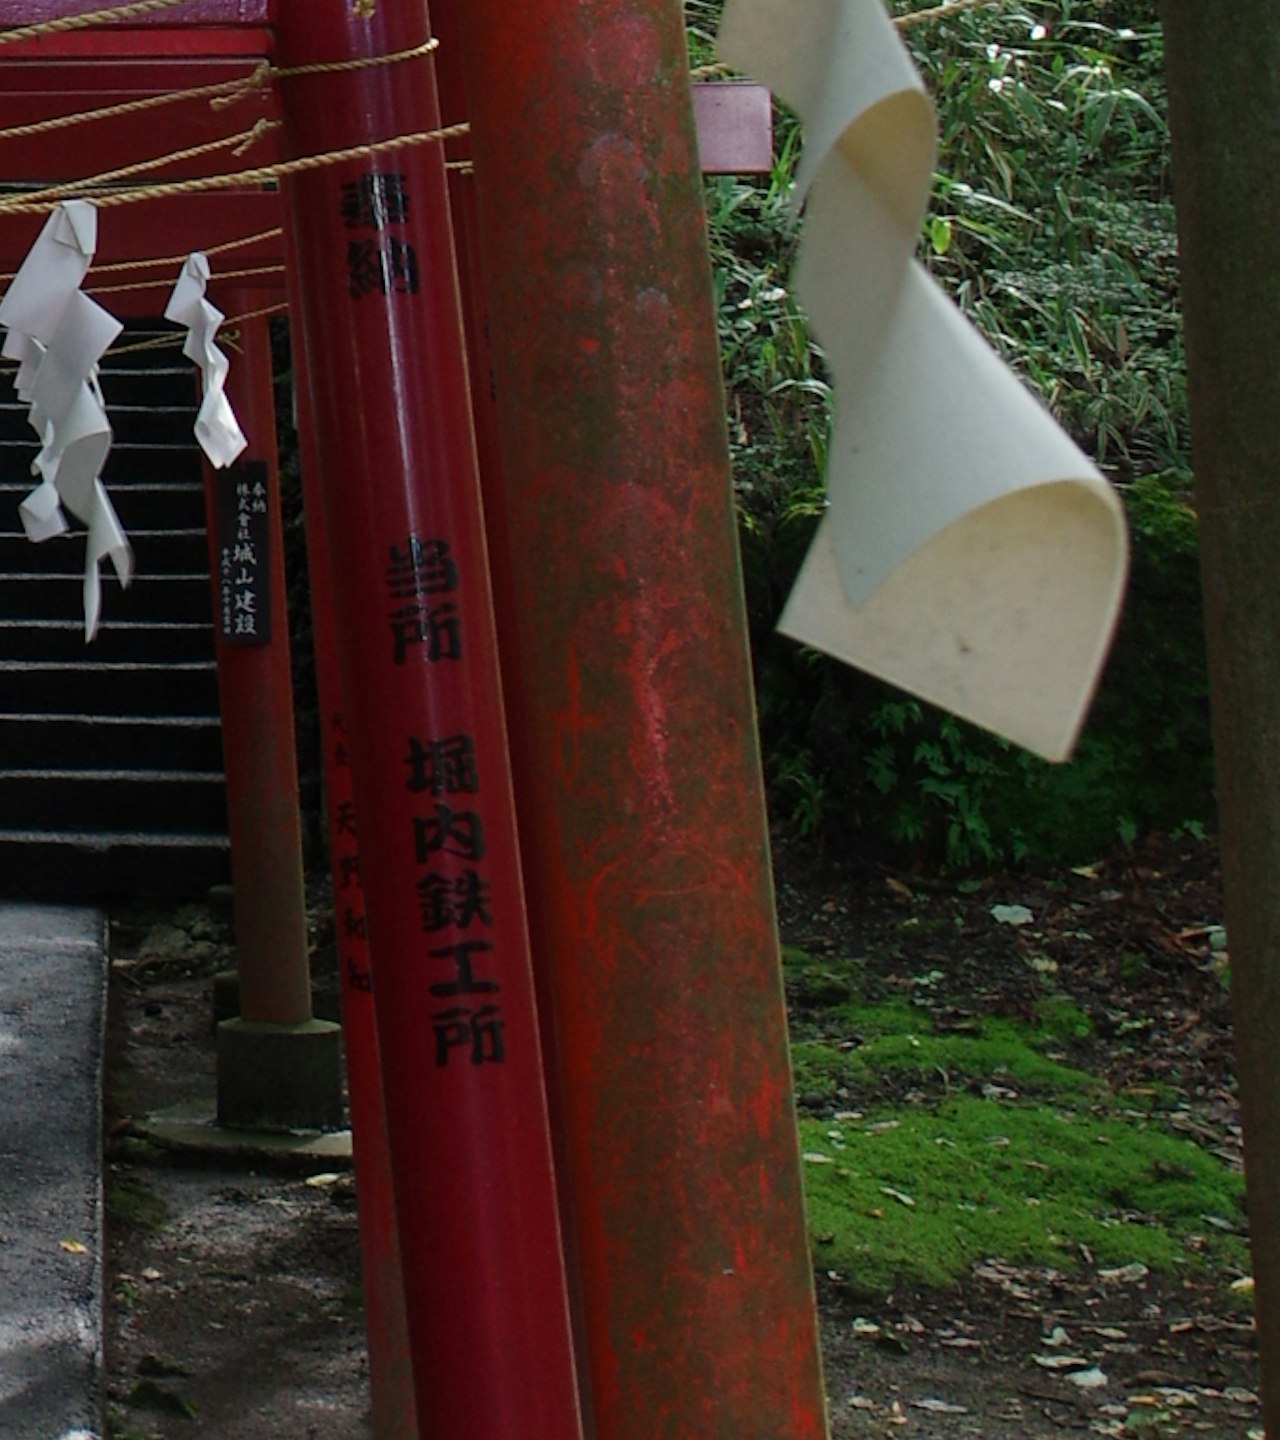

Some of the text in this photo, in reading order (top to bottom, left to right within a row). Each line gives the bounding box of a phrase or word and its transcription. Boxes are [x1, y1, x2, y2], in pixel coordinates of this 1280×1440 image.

[405, 734, 505, 1067] 堀内鉄工所
